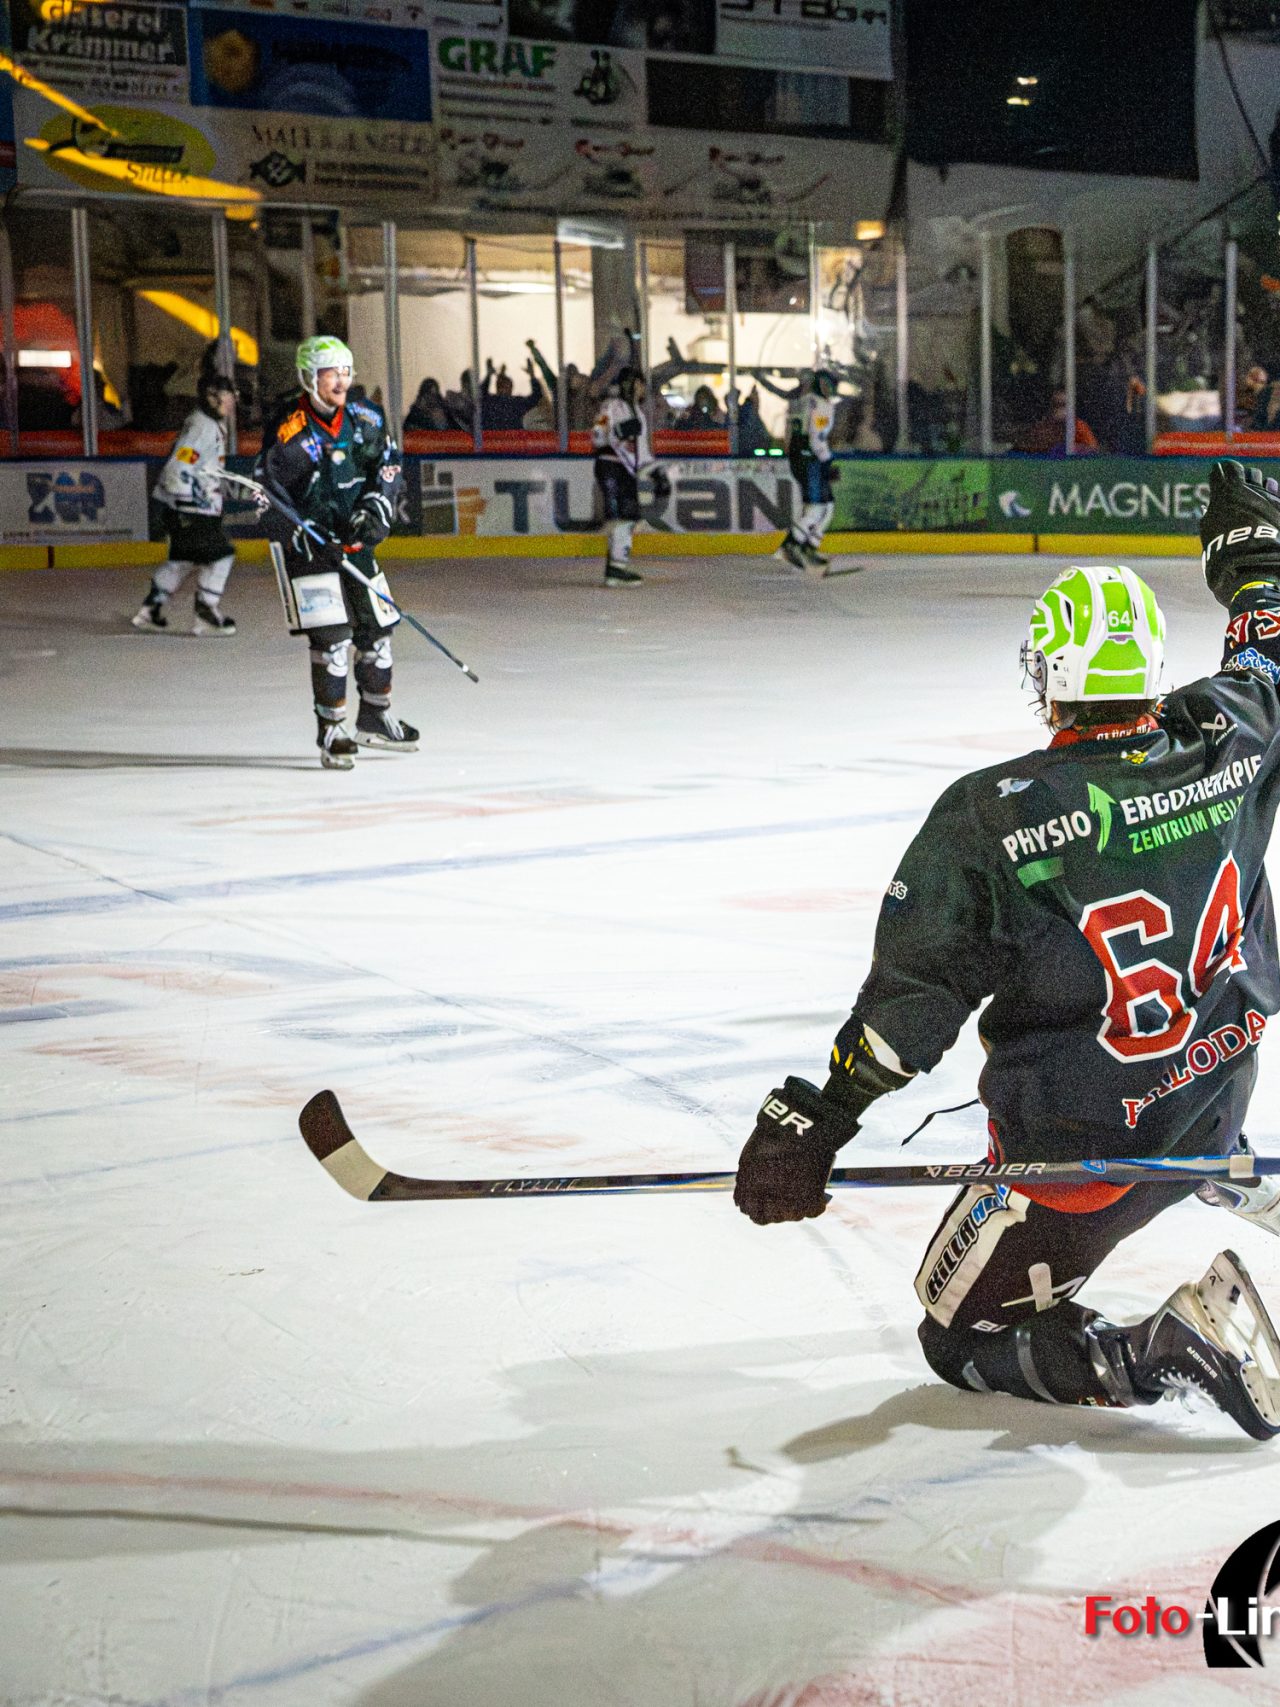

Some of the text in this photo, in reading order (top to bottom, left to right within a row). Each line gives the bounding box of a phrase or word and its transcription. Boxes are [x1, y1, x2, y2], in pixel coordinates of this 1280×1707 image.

[437, 36, 557, 78] GRAF
[1048, 481, 1210, 519] MAGNES
[1108, 610, 1131, 628] 64
[1002, 810, 1092, 862] PHYSIO
[1128, 811, 1208, 854] ZENTRUM
[1078, 850, 1248, 1064] 64
[944, 1162, 1048, 1178] BAUER
